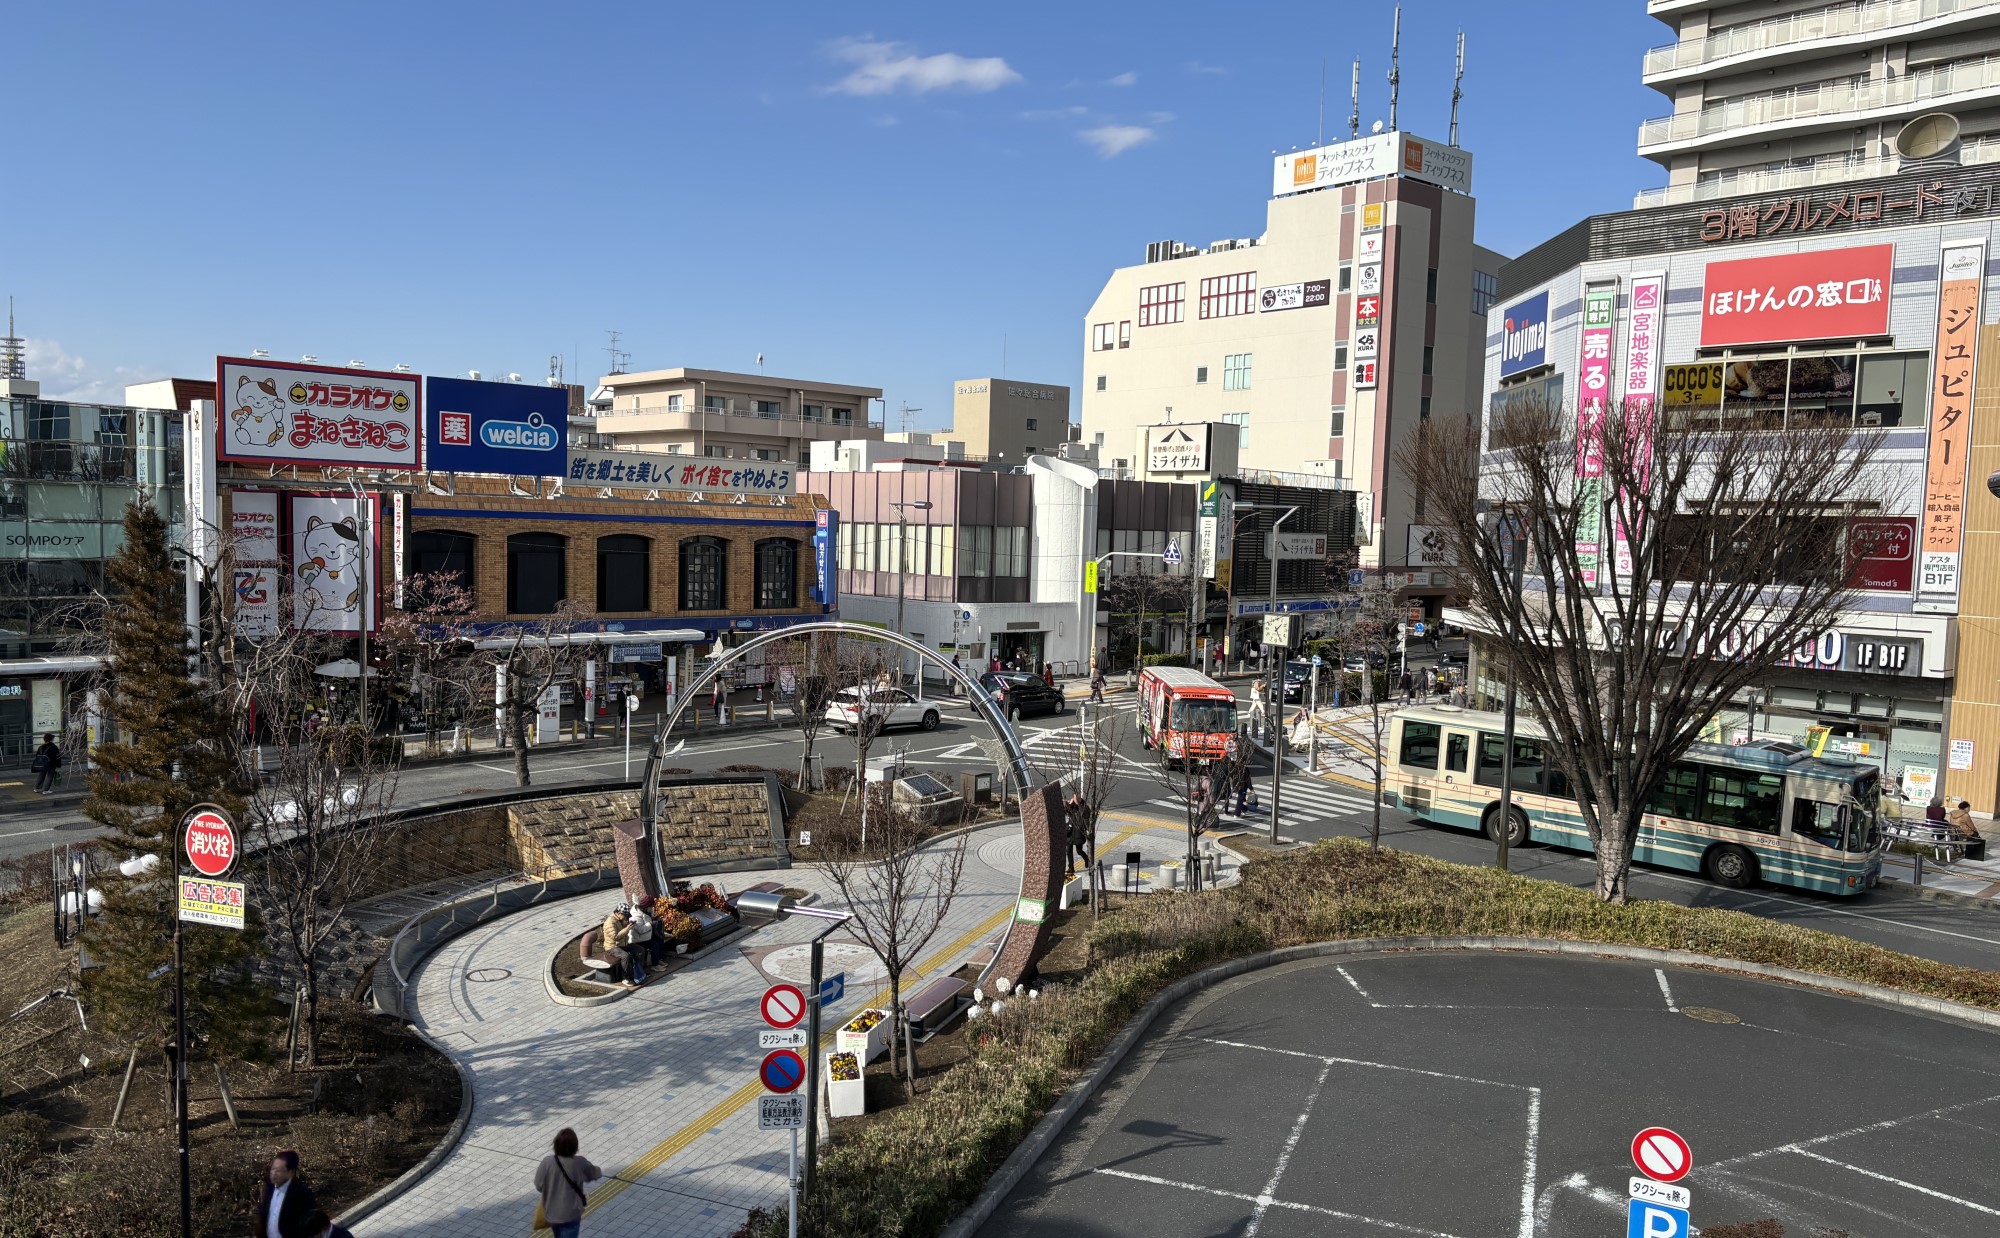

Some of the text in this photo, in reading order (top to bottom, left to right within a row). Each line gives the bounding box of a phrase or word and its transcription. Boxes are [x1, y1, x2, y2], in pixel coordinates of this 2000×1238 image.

[1319, 143, 1376, 163] フィットネスクラブ
[1425, 147, 1466, 166] フィットネスクラブ
[1319, 158, 1375, 180] ティップネス
[1424, 160, 1465, 184] ティップネス
[1700, 182, 1943, 241] 3階グルメロード
[1305, 294, 1325, 302] 22:00
[1589, 300, 1609, 312] 買取
[1709, 279, 1871, 316] ほけんの窓口
[1359, 298, 1377, 316] 本
[1588, 312, 1608, 324] 専門
[1358, 335, 1374, 345] くら
[1629, 313, 1651, 390] 宮地楽器
[1666, 365, 1722, 391] COCO'S
[1938, 306, 1974, 465] ジュピター
[307, 384, 393, 411] カラオケ
[1008, 386, 1055, 400] 佐々総合病院
[1682, 391, 1703, 404] 3F
[290, 410, 410, 452] まねきねこ
[444, 416, 467, 440] 薬
[488, 425, 550, 447] welcia
[1153, 455, 1200, 468] ミライザカ
[570, 457, 789, 490] 街を郷土を美しく ポイ捨てをやめよう
[1930, 493, 1960, 501] コーヒー
[1927, 503, 1960, 512] 輸入食品
[1934, 514, 1952, 522] 菓子
[6, 535, 84, 546] SOMPOケア
[1203, 520, 1212, 574] 三井住友銀行
[1930, 536, 1954, 544] ワイン
[1291, 545, 1314, 554] ミライザカ
[1421, 552, 1445, 562] KURA
[1924, 564, 1955, 572] 専門店街
[1924, 574, 1953, 585] B1F
[1857, 643, 1873, 666] 1F
[1879, 644, 1906, 668] B1F
[195, 820, 226, 830] FIRE HYDRANT
[191, 831, 230, 858] 消火栓
[183, 882, 242, 907] 広告募集
[762, 1033, 804, 1045] タクシーを除く
[762, 1098, 802, 1108] タクシーを除く
[763, 1117, 801, 1127] ここから
[1633, 1182, 1687, 1204] タクシーを除く
[1644, 1207, 1678, 1238] P
